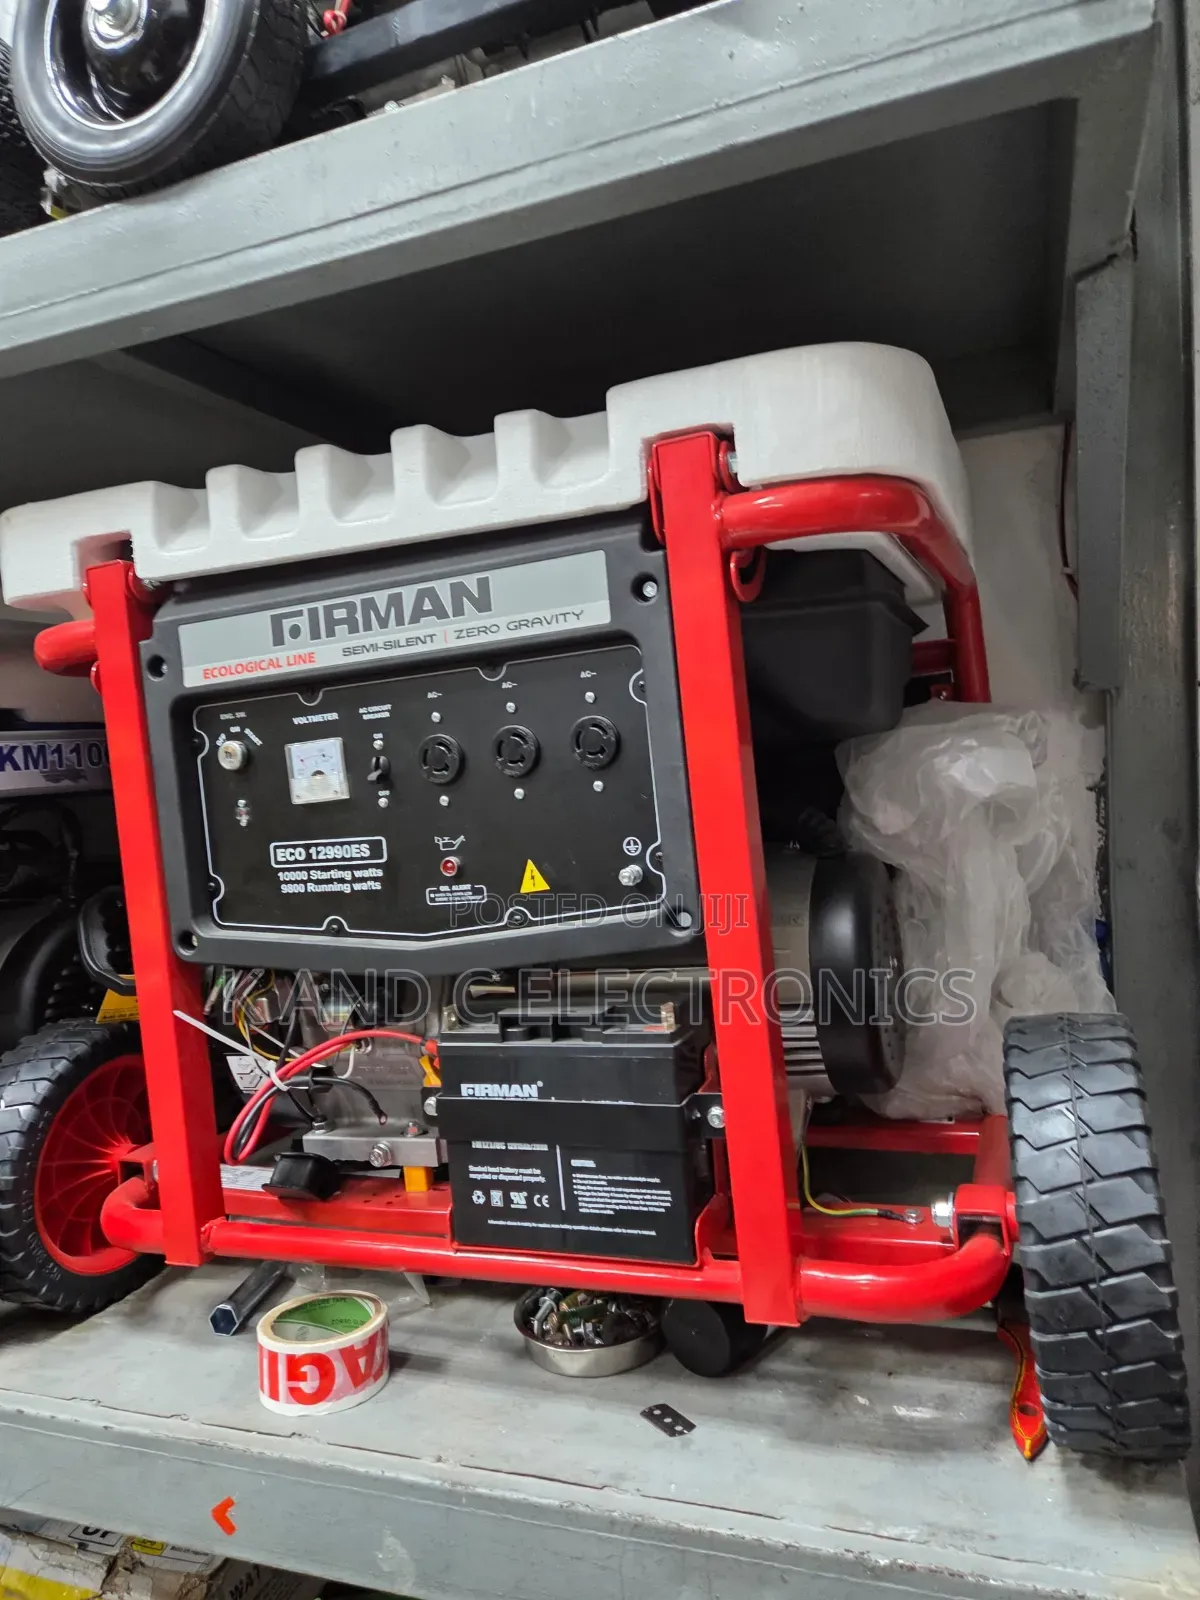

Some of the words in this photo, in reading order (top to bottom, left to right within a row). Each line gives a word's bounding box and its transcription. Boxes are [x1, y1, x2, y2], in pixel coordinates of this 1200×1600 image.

[269, 575, 493, 647] FIRMAN
[341, 633, 438, 657] SEMI-SILENT
[453, 623, 501, 640] ZERO
[506, 609, 584, 631] GRAVITY
[202, 657, 283, 680] ECOLOGICAL
[286, 651, 317, 667] LINE
[292, 712, 339, 725] VOLTMETER
[0, 742, 109, 772] KM110
[276, 847, 306, 861] ECO
[309, 844, 371, 860] 12990ES
[277, 870, 308, 881] 10000
[309, 869, 352, 880] Starting
[353, 868, 383, 878] watts
[281, 883, 305, 894] 9800
[307, 882, 351, 893] Running
[352, 880, 382, 891] watts
